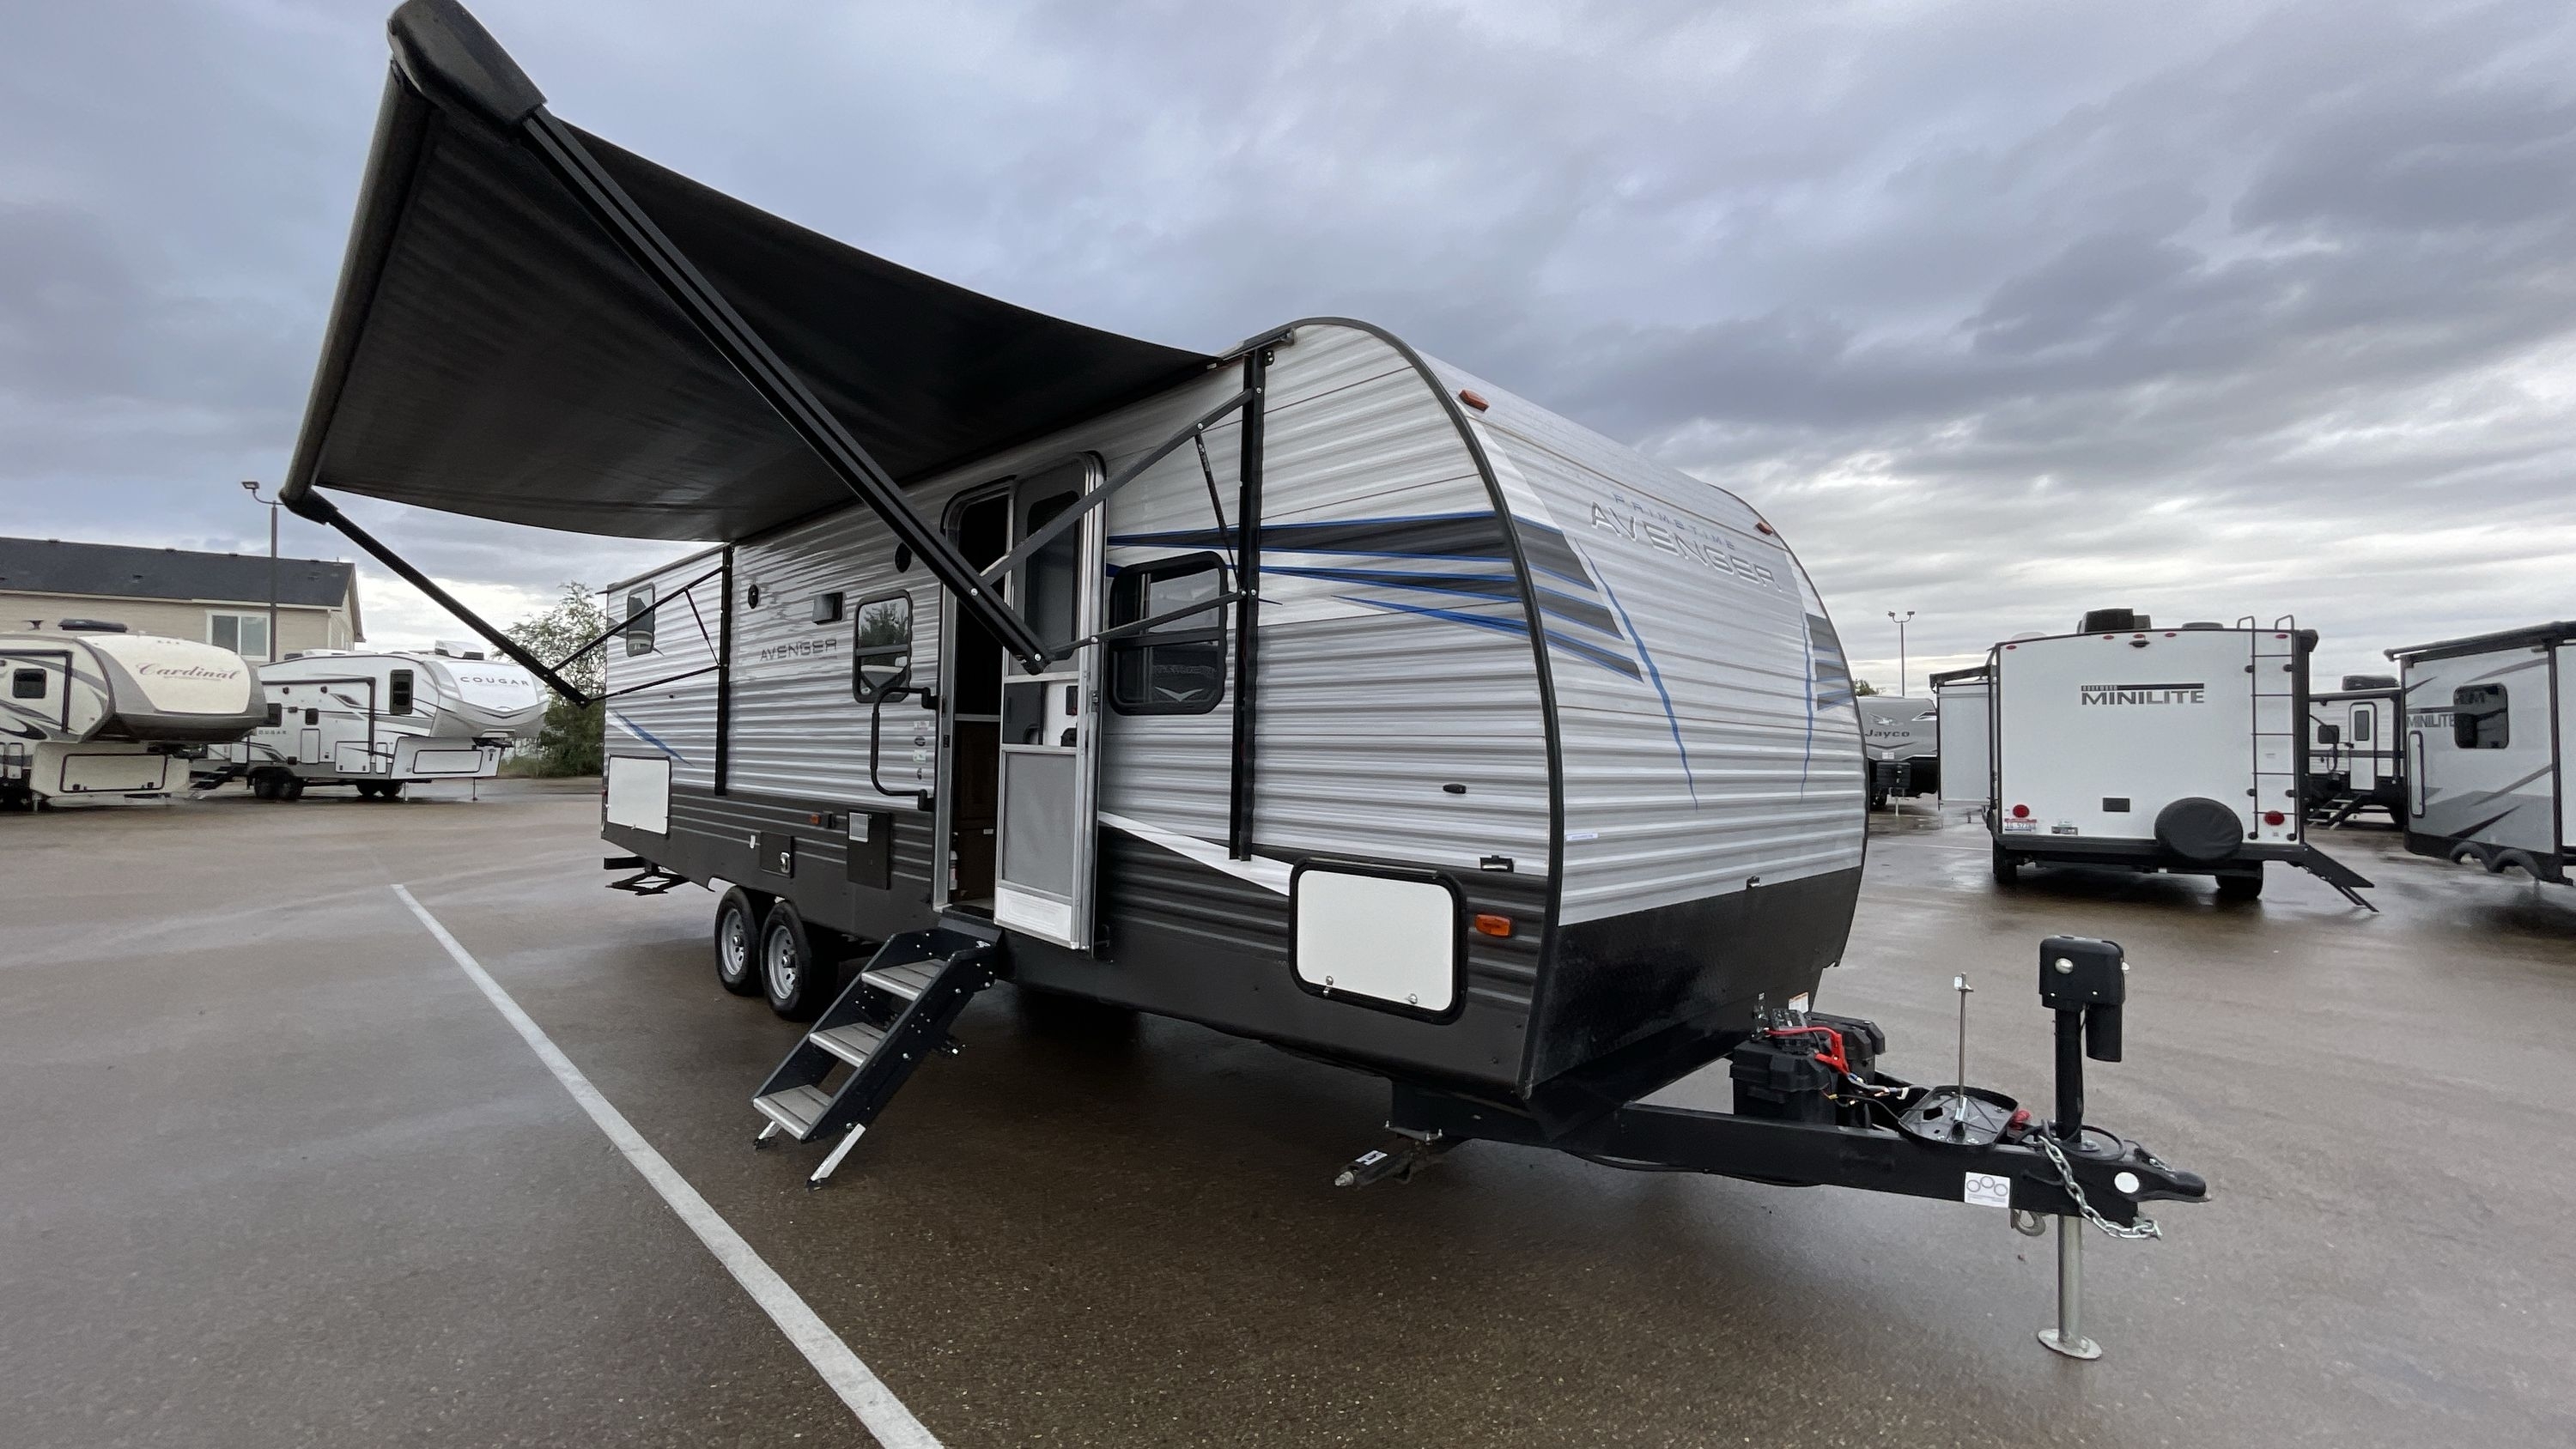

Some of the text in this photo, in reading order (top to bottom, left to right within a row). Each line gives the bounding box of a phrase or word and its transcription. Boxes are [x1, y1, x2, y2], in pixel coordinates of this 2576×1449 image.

[1591, 500, 1783, 592] AVENGER
[760, 639, 837, 662] AVENGER
[136, 662, 240, 679] Cardinal
[460, 676, 529, 686] COUGAR
[2081, 690, 2205, 705] MINILITE
[1864, 729, 1911, 738] Jayco
